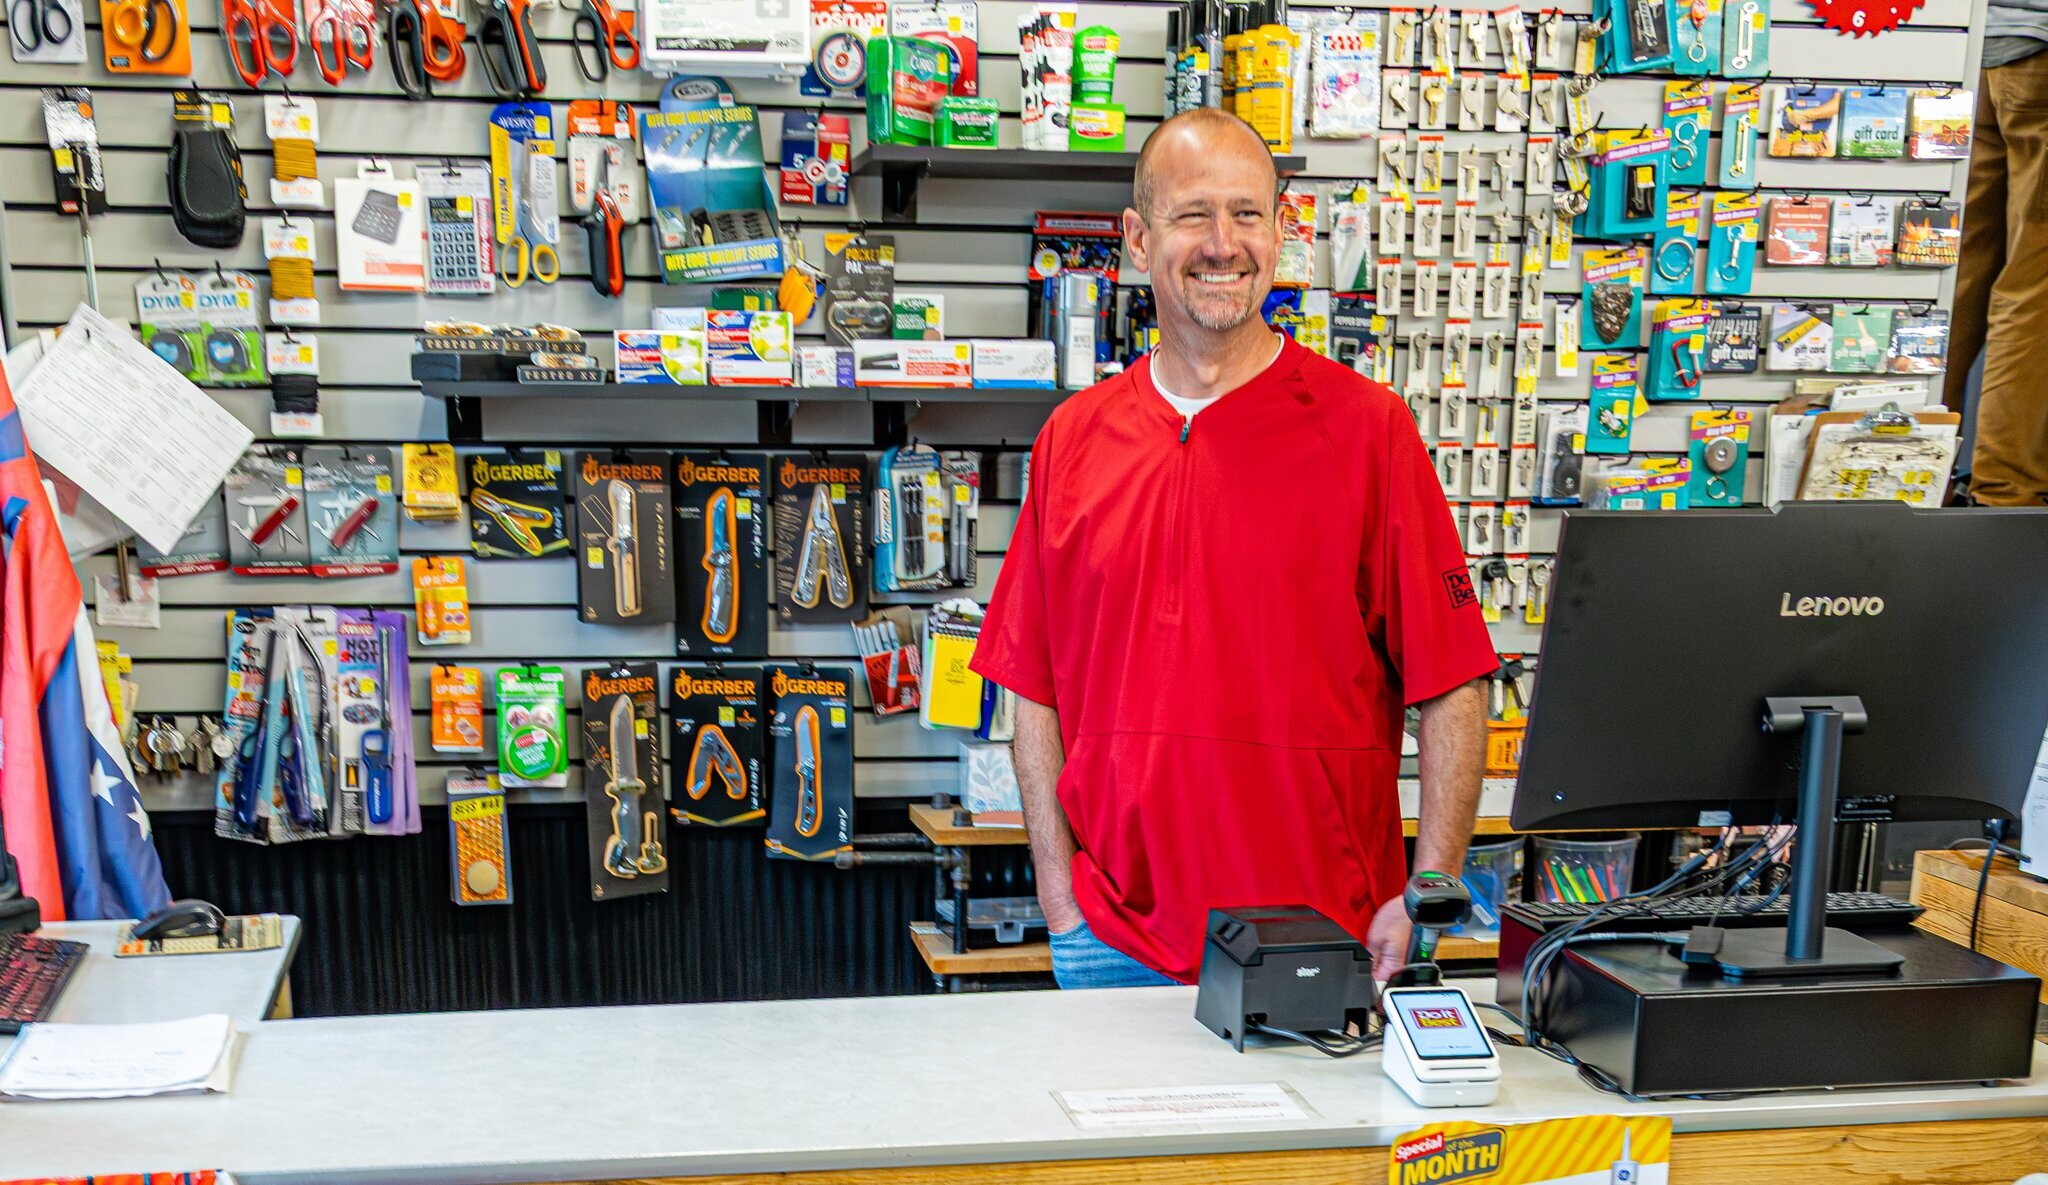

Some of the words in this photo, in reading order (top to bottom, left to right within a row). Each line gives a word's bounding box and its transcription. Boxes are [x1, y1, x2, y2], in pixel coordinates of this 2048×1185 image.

[812, 11, 887, 28] rosman
[1853, 10, 1865, 27] 6
[1855, 126, 1872, 141] gift
[1876, 127, 1899, 140] card
[142, 297, 181, 310] DYM
[199, 296, 237, 308] DYM
[482, 339, 498, 350] XX
[1712, 344, 1731, 363] gift
[1732, 346, 1756, 361] card
[524, 370, 575, 381] TESTED
[580, 370, 597, 381] XX
[488, 463, 556, 482] GERBER
[599, 464, 663, 480] GERBER
[695, 466, 760, 483] GERBER
[797, 468, 861, 483] GERBER
[1447, 574, 1470, 589] Do
[1452, 588, 1476, 604] Be
[1780, 592, 1885, 617] Lenovo
[601, 677, 654, 695] GERBER
[692, 680, 756, 696] GERBER
[787, 680, 846, 696] GERBER
[1396, 1134, 1443, 1160] Special
[1403, 1144, 1499, 1185] MONTH
